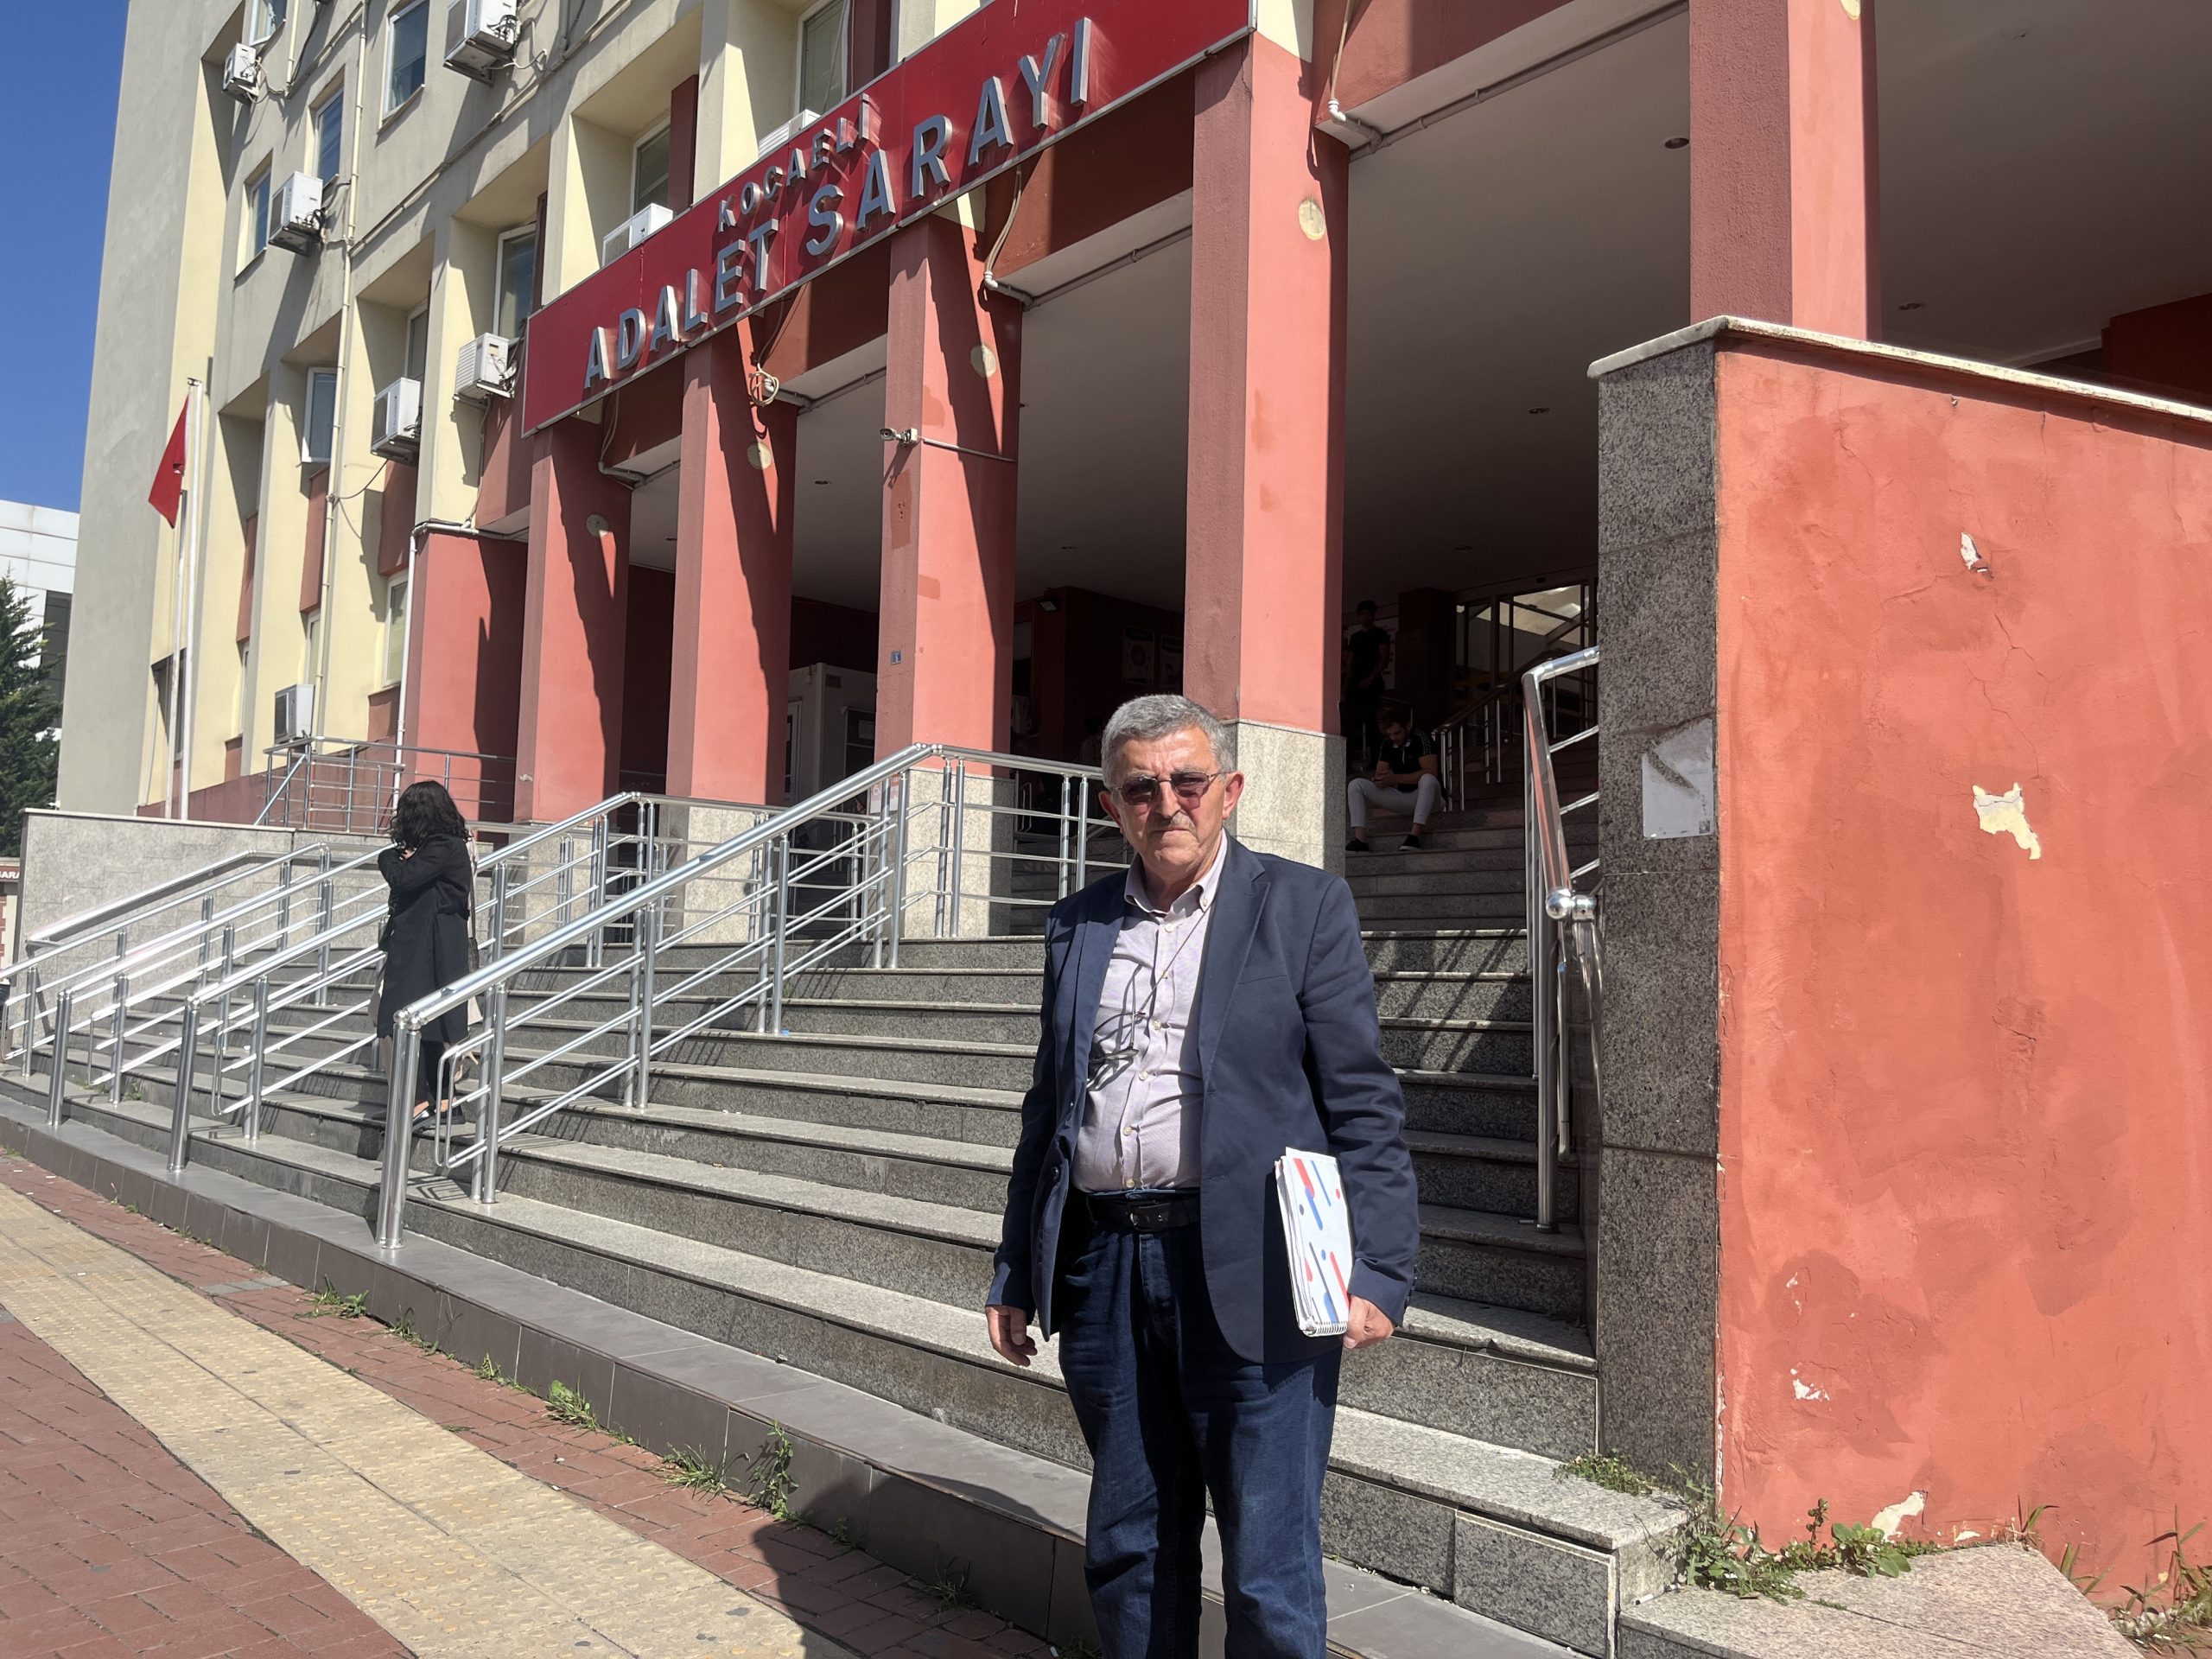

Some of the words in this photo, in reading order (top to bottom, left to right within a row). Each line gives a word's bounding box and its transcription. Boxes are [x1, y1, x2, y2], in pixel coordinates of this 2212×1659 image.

[584, 218, 779, 389] ADALET
[805, 16, 1091, 257] SARAYI
[718, 92, 869, 232] KOCAELİ
